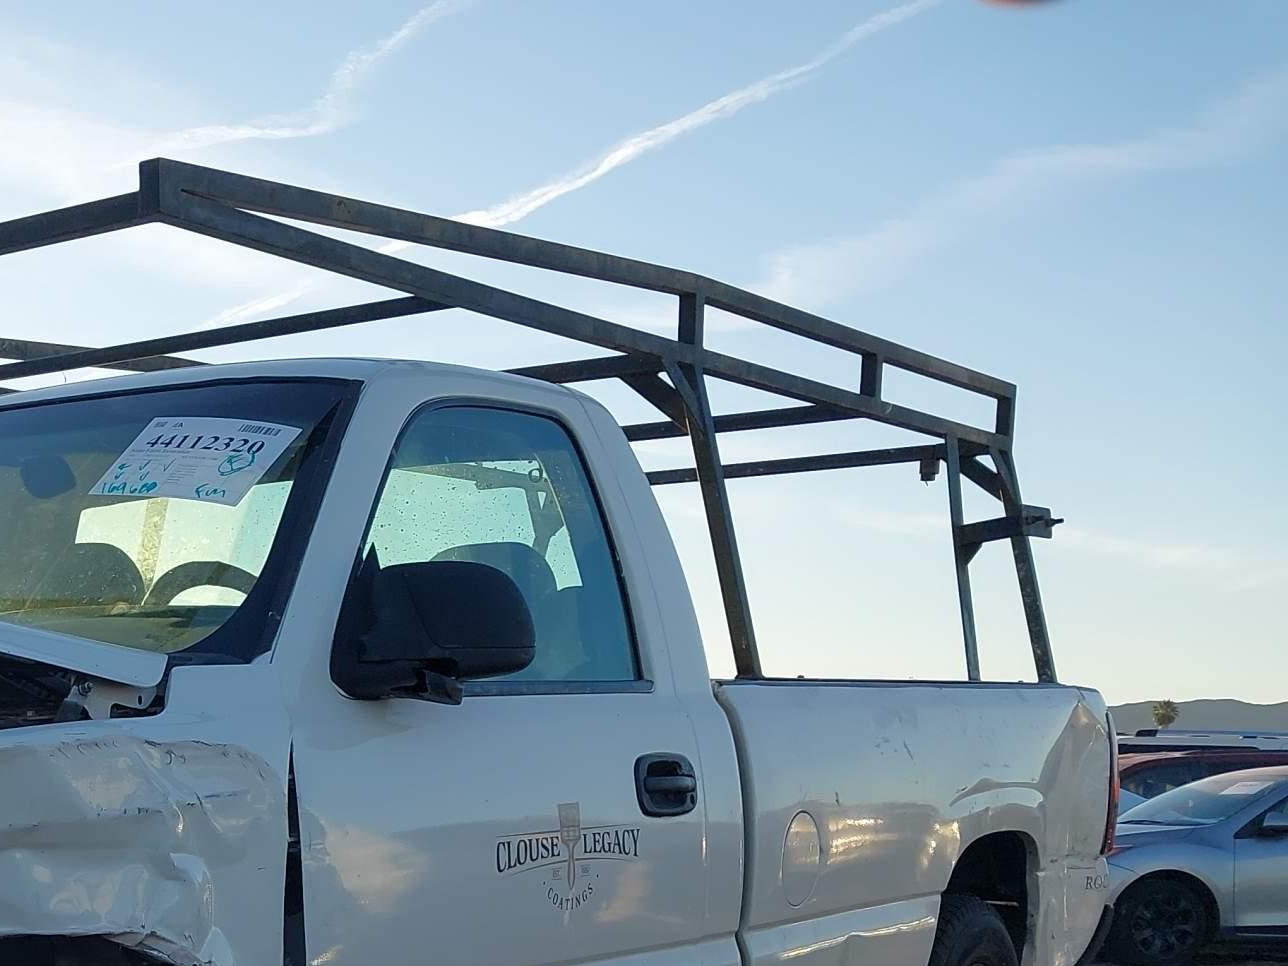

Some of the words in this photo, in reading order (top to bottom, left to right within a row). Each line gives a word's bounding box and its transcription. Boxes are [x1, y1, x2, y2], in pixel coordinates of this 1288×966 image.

[145, 433, 266, 455] 44112320
[496, 835, 561, 873] CLOUSE
[582, 829, 640, 857] LEGACY
[547, 882, 593, 911] COATINGS
